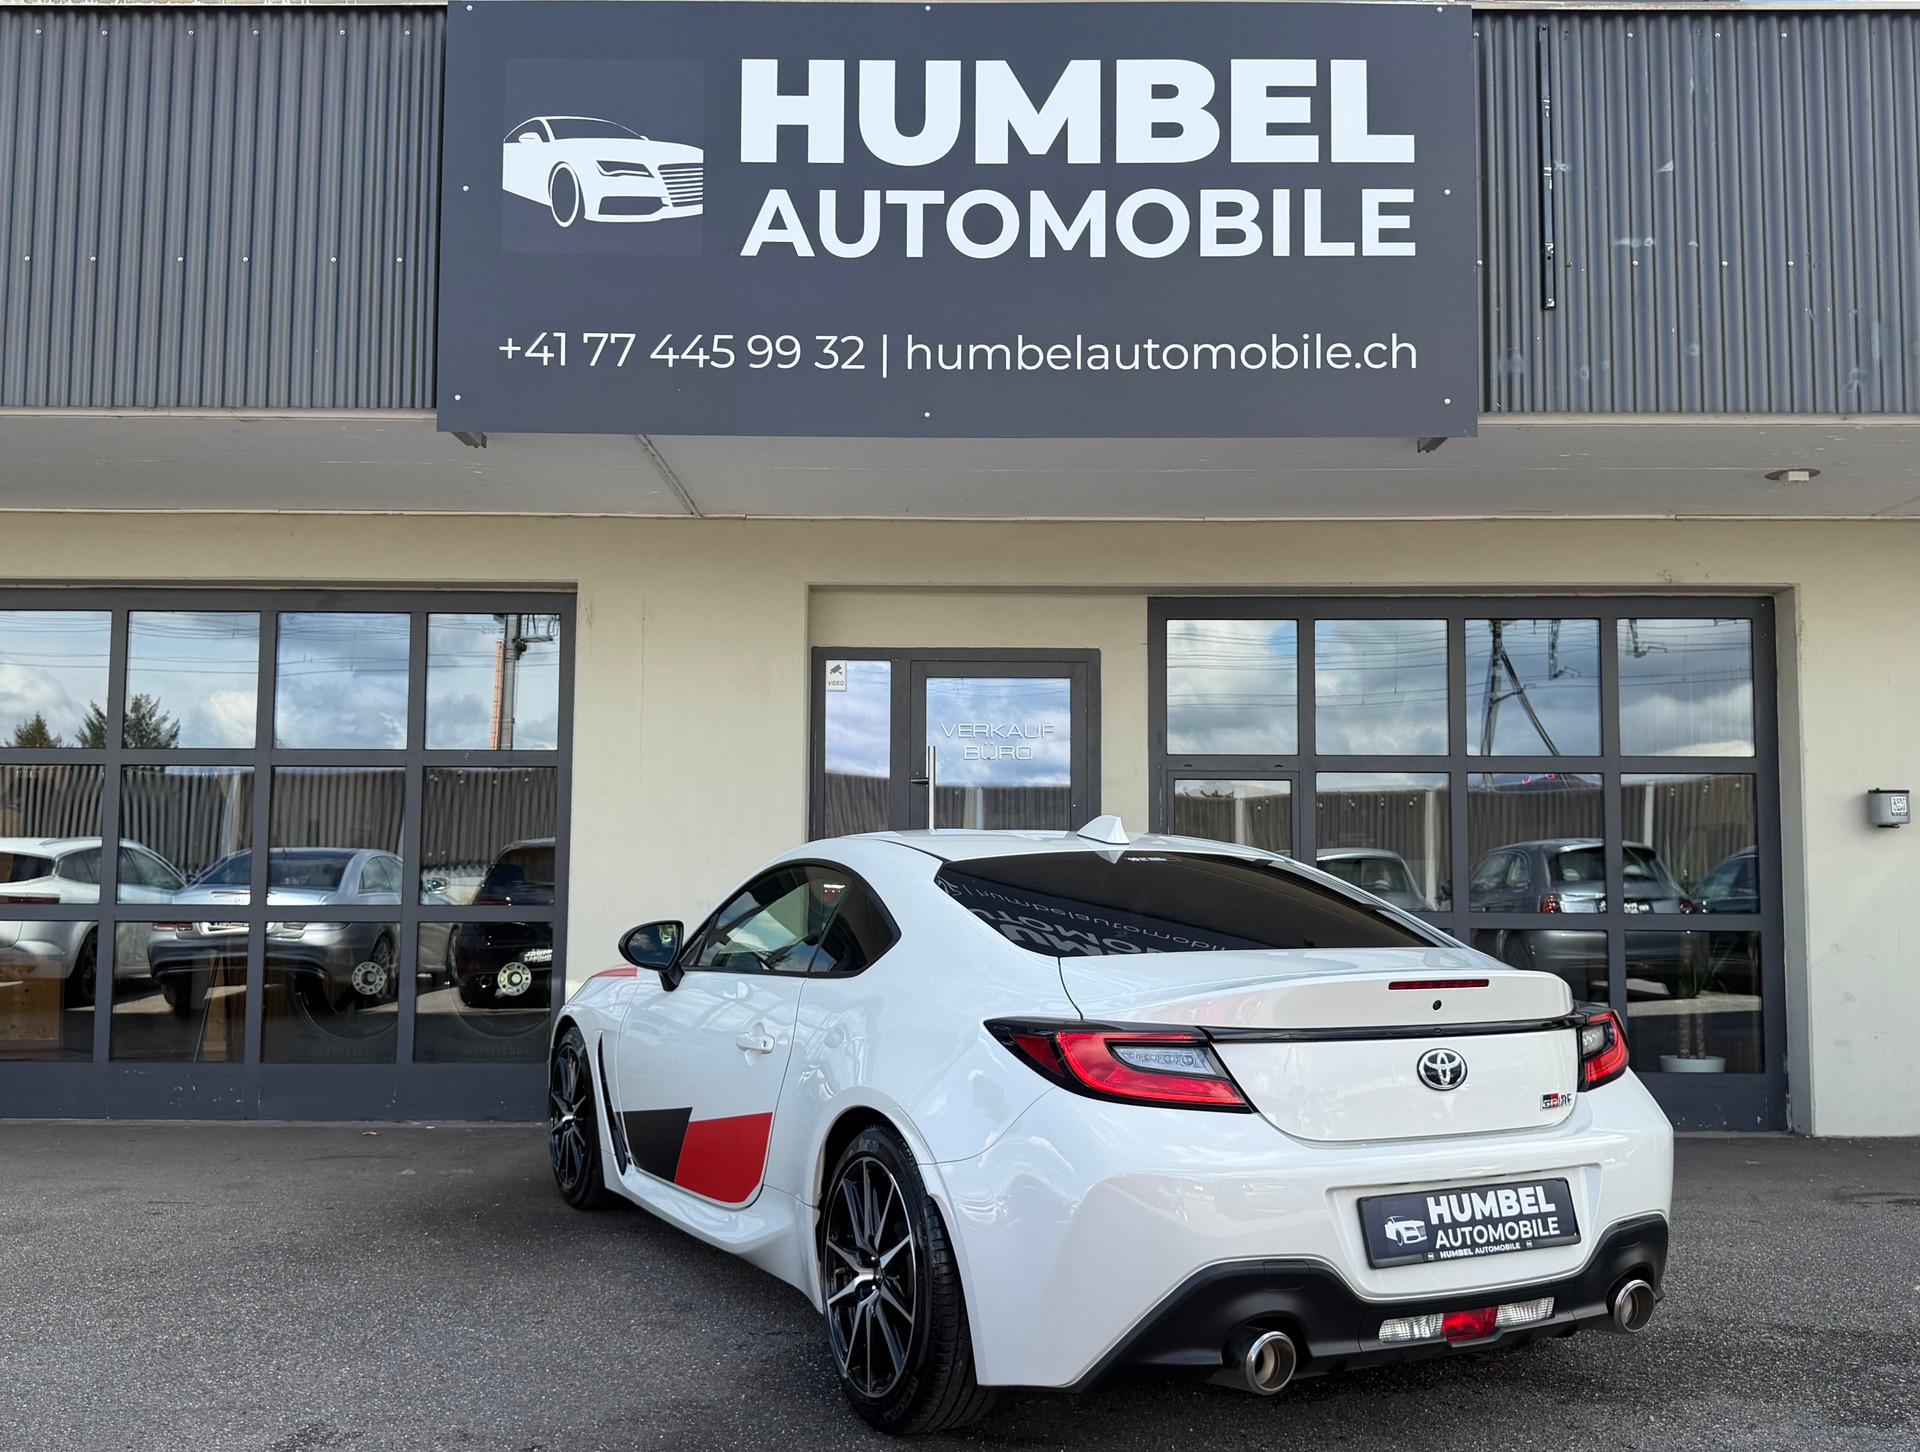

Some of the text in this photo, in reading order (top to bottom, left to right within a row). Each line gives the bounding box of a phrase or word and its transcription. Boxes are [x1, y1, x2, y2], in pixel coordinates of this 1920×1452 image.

[740, 58, 1416, 167] HUMBEL
[740, 188, 1416, 259] AUTOMOBILE
[498, 332, 567, 367] +41
[582, 332, 637, 367] 77
[649, 333, 735, 369] 445
[747, 334, 801, 369] 99
[814, 335, 866, 370] 32
[907, 332, 1417, 371] humbelautomobile.ch
[941, 723, 1055, 738] VERKAUF
[964, 742, 1033, 760] BÜRO
[1426, 1186, 1556, 1225] HUMBEL
[1435, 1217, 1560, 1249] AUTOMOBILE
[1440, 1242, 1521, 1259] HUMBEL AUTOMOBILE
